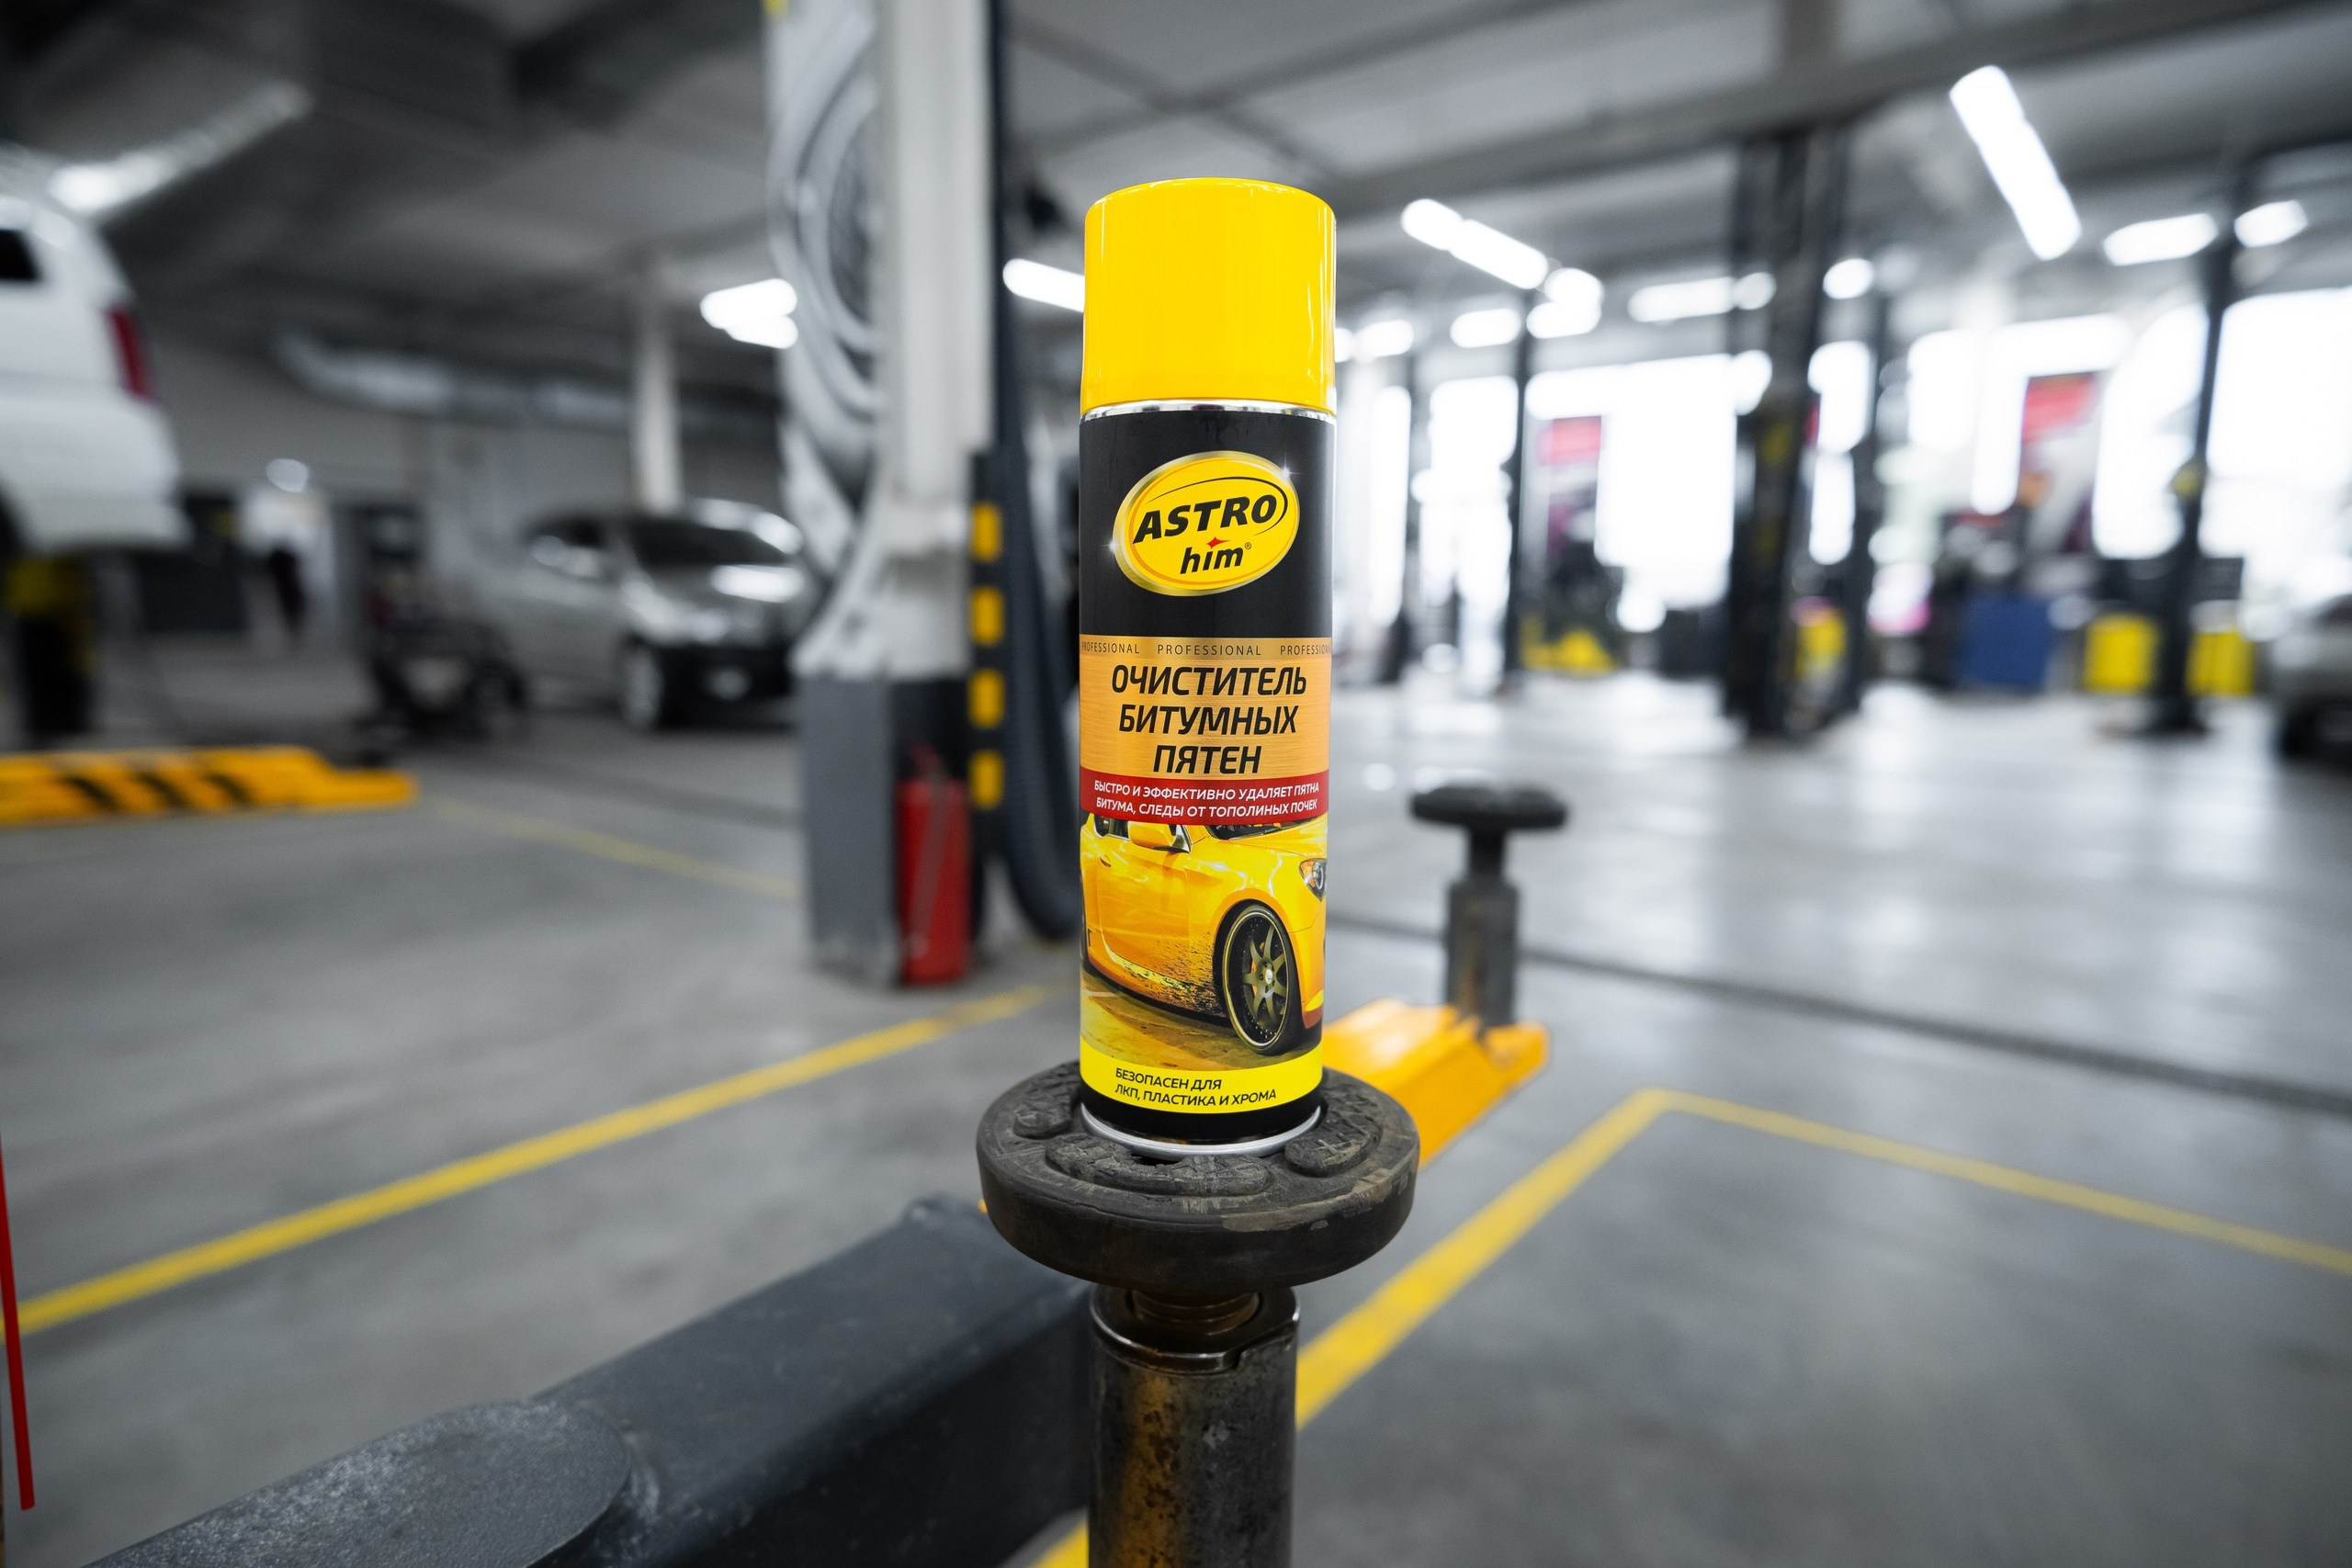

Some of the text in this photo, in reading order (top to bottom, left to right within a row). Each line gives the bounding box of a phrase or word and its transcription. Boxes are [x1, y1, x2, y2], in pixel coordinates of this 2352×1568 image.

[1133, 494, 1277, 544] ASTRO
[1158, 644, 1261, 656] PROFESSIONAL
[1112, 664, 1306, 696] ОЧИСТИТЕЛЬ
[1119, 704, 1299, 735] БИТУМНЫХ
[1153, 745, 1261, 773] ПЯТЕН
[1094, 780, 1319, 801] БЫСТРО И ЭФФЕКТИВНО УДАЛЯЕТ ПЯТНА
[1096, 797, 1317, 818] БИТУМА, СЛЕДЫ ОТ ТОПОЛИНЫХ ПОЧЕК
[1115, 1067, 1222, 1091] БЕЗОПАСЕН ДЛЯ
[1114, 1084, 1276, 1106] ЛКП, ПЛАСТИКА И ХРОМА
